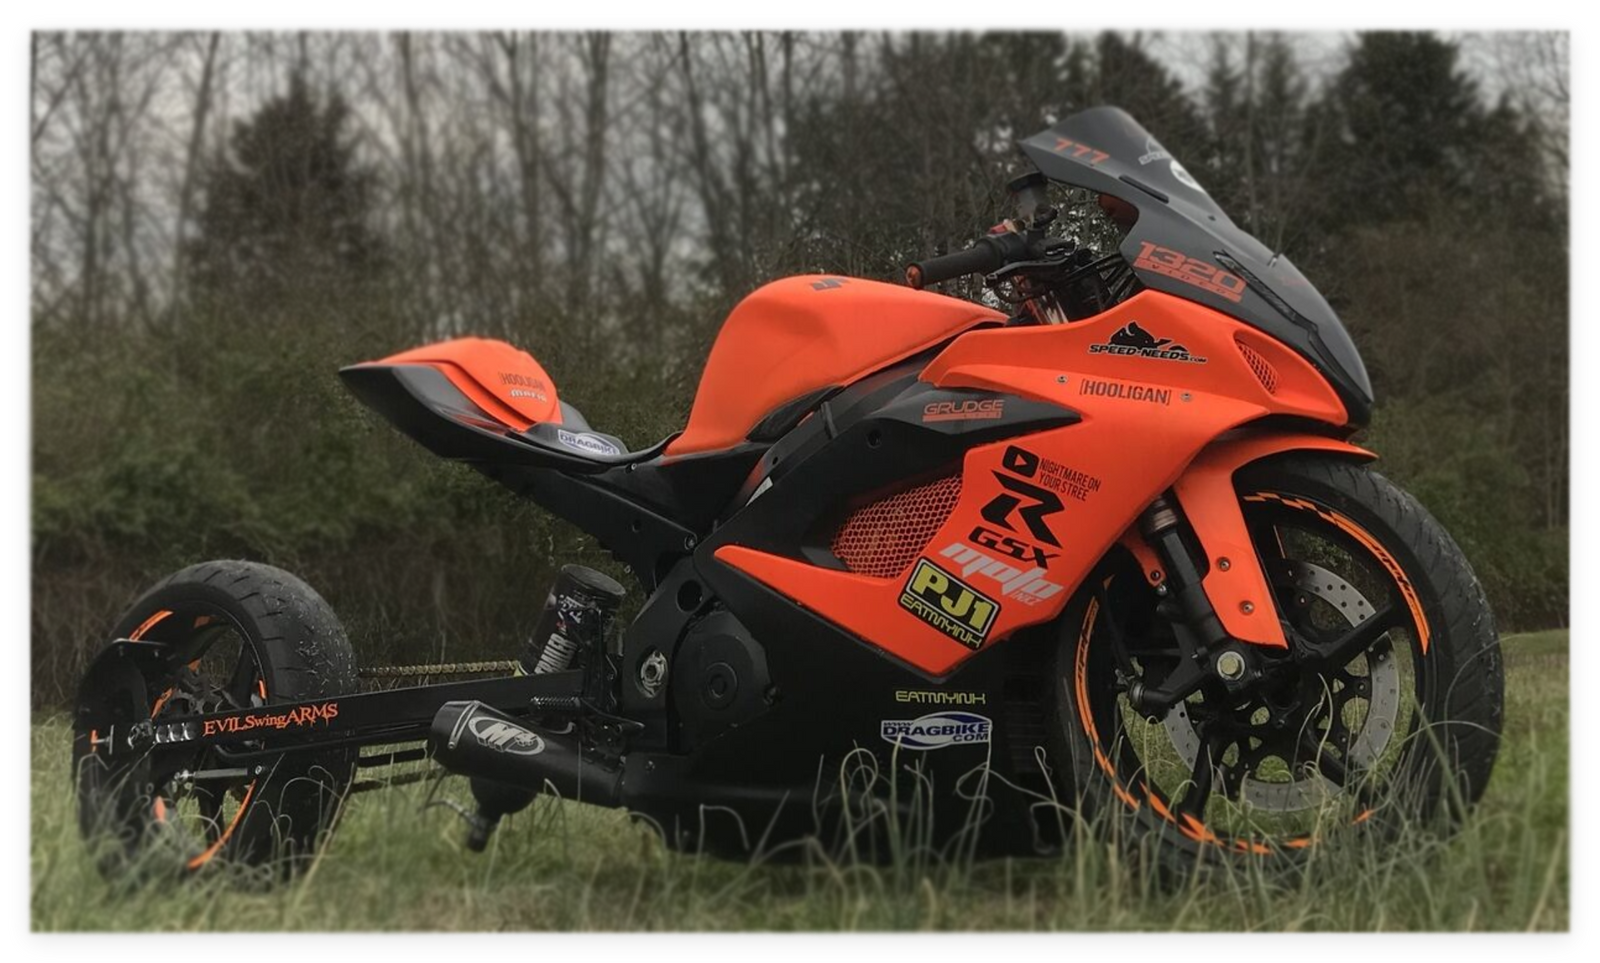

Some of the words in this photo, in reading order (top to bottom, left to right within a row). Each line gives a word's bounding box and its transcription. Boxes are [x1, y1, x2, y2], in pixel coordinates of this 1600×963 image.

[1053, 137, 1110, 163] 777
[1139, 240, 1247, 294] 1320
[924, 399, 1004, 415] GRUDGE
[1039, 457, 1089, 488] NIGHTMARE
[1087, 476, 1102, 492] ON
[1039, 471, 1061, 492] YOUR
[968, 525, 1061, 570] GSX
[911, 563, 994, 632] PJ1
[900, 593, 983, 649] EATMYINK
[894, 690, 987, 705] EATMYINK
[882, 723, 989, 737] DRAGBIKE
